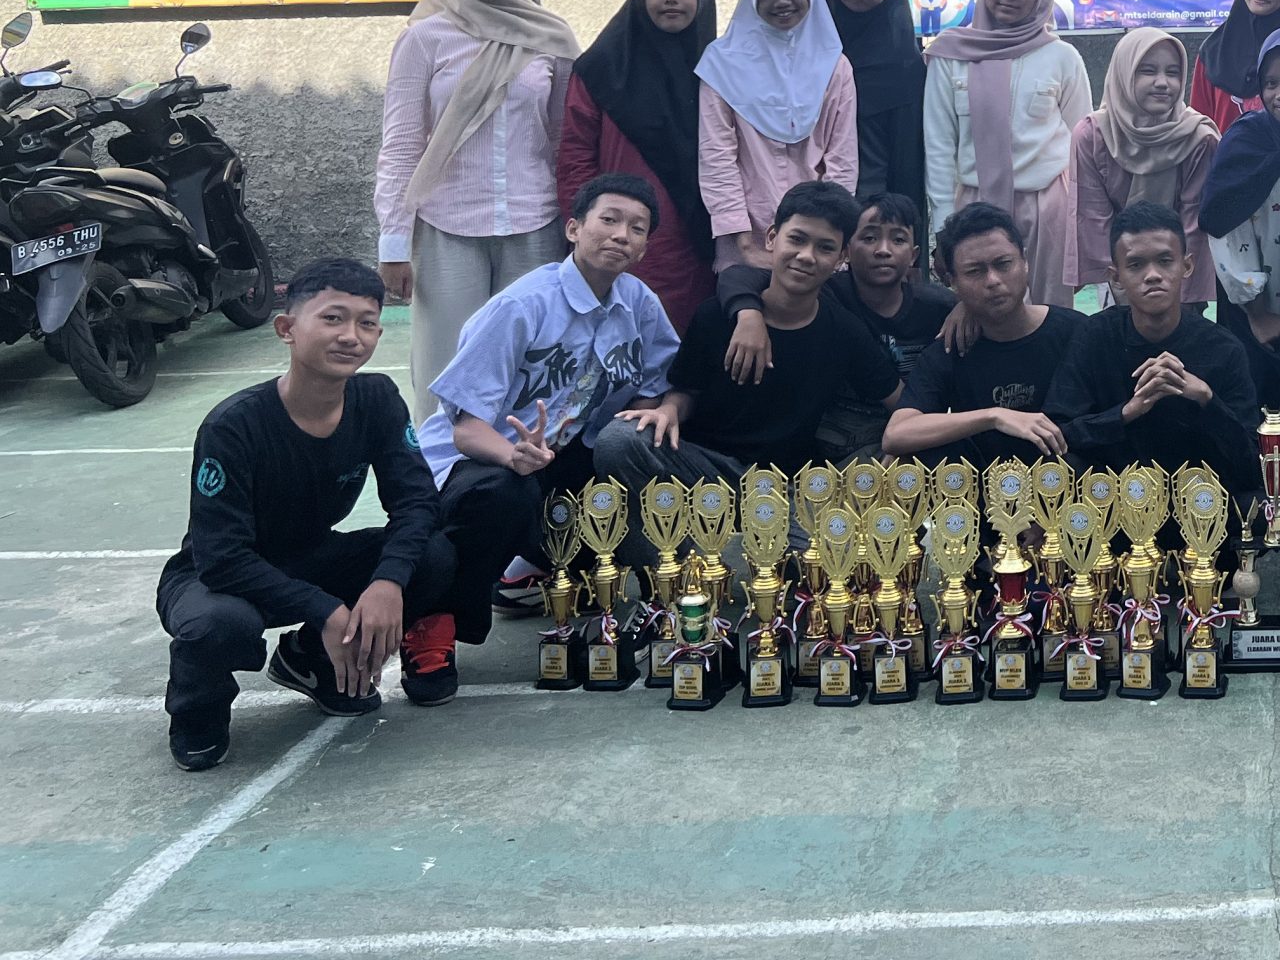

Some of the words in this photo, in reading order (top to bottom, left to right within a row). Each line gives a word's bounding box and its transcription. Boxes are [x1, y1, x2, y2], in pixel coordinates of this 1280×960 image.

[1123, 10, 1230, 21] mtseldarain@gmail.co
[17, 246, 26, 259] B
[32, 235, 65, 254] 4556
[72, 226, 99, 243] THU
[1251, 635, 1275, 644] JUARA
